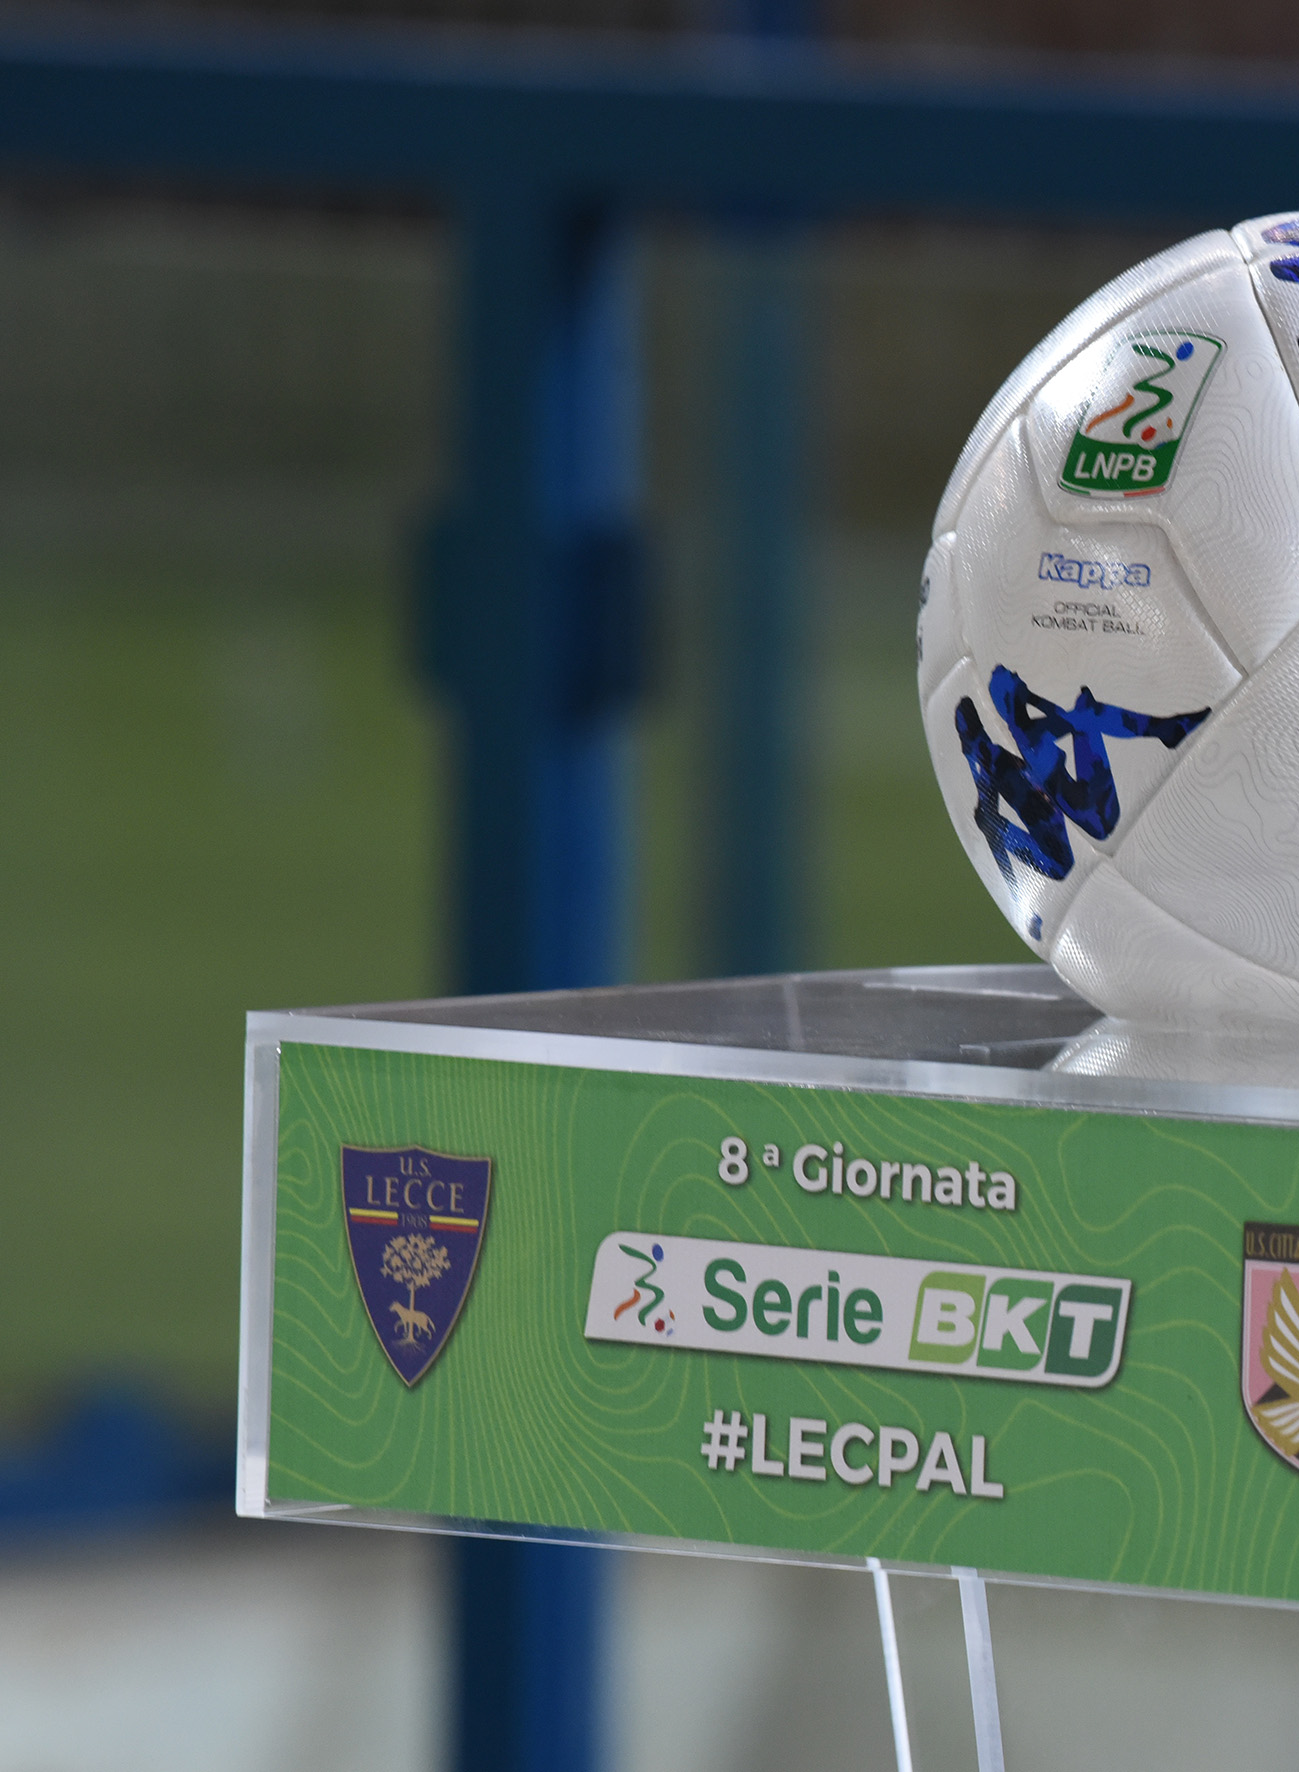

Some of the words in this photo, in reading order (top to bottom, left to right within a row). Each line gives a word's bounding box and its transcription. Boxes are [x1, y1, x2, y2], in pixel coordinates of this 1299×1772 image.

[1075, 451, 1158, 482] LNPB
[1038, 552, 1151, 589] Kappa
[1031, 613, 1098, 633] KOMBAT
[1102, 618, 1145, 635] BALL
[1054, 601, 1121, 618] OFFICIAL
[366, 1175, 465, 1213] LECCE
[792, 1141, 1016, 1210] Giornata
[703, 1257, 884, 1345] Serie
[917, 1286, 1113, 1360] BKT
[701, 1409, 1004, 1499] #LECPAL
